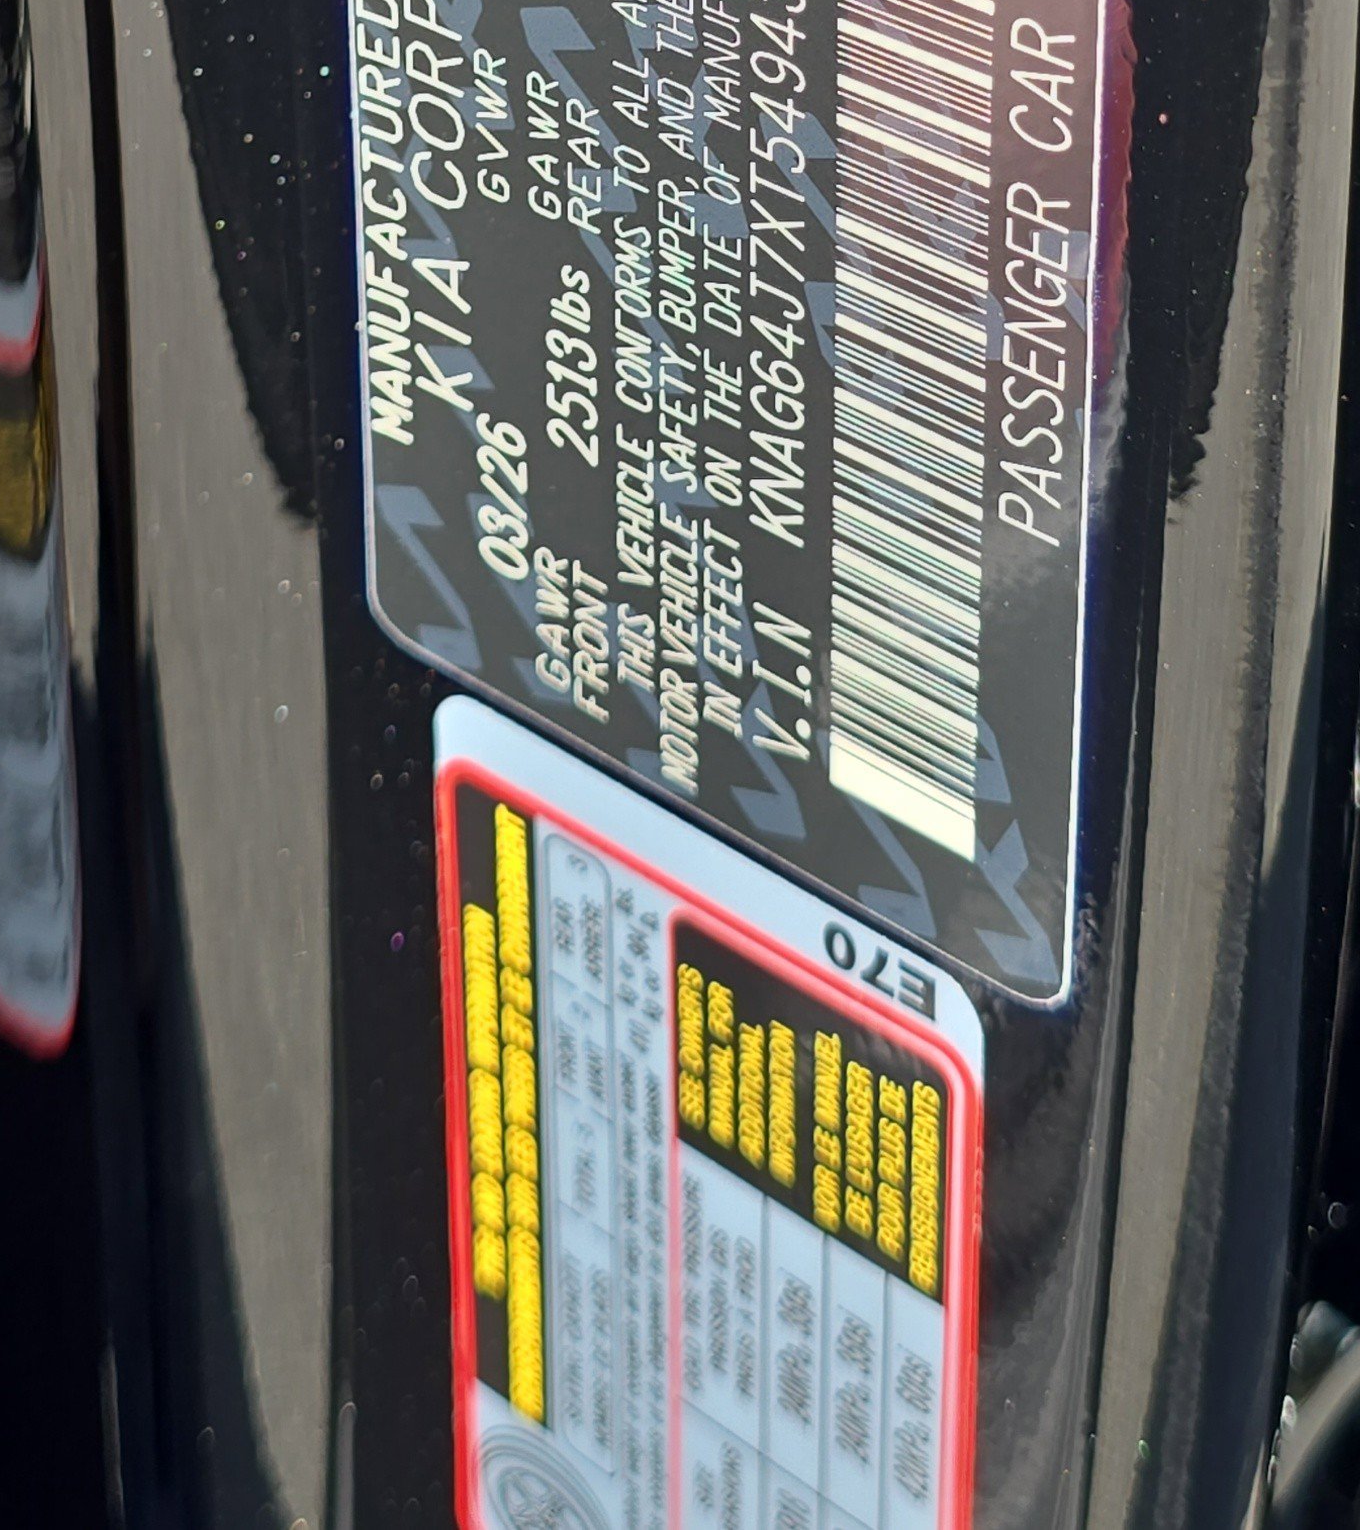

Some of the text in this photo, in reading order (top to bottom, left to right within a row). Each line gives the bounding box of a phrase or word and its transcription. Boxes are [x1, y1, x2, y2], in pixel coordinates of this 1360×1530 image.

[472, 45, 513, 203] GVWR
[523, 69, 563, 220] GAWR
[564, 95, 603, 234] REAR
[610, 54, 651, 128] ALL
[655, 75, 696, 161] AND
[612, 143, 652, 193] TO
[702, 144, 742, 205] OF
[613, 215, 655, 413] CONFORMS
[656, 173, 703, 333] BUMPER,
[702, 222, 743, 337] DATE
[997, 14, 1077, 547] PASSENGER CAR
[410, 253, 473, 412] KIA
[702, 346, 743, 429] THE
[656, 338, 703, 493] SAFETY,
[702, 442, 744, 508] ON
[474, 410, 531, 580] 03/26
[614, 422, 656, 586] VEHICLE
[532, 545, 573, 694] GAWR
[570, 558, 611, 723] FRONT
[616, 601, 656, 692] THIS
[658, 499, 700, 666] VEHICLE
[702, 515, 744, 677] EFFECT
[659, 667, 700, 797] MOTOR
[703, 678, 744, 739] IN
[822, 920, 937, 1020] E70
[677, 1069, 705, 1129] SEE
[706, 979, 735, 1148] MANUAL FOR
[738, 1020, 765, 1169] ADDITIONAL
[768, 1018, 796, 1187] INFORMATION
[813, 1028, 842, 1230] VOIR LE MANUEL
[845, 1183, 872, 1239] DE
[876, 1073, 907, 1261] POUR PLUS DE
[908, 1078, 941, 1294] RENSEIGNEMENTS
